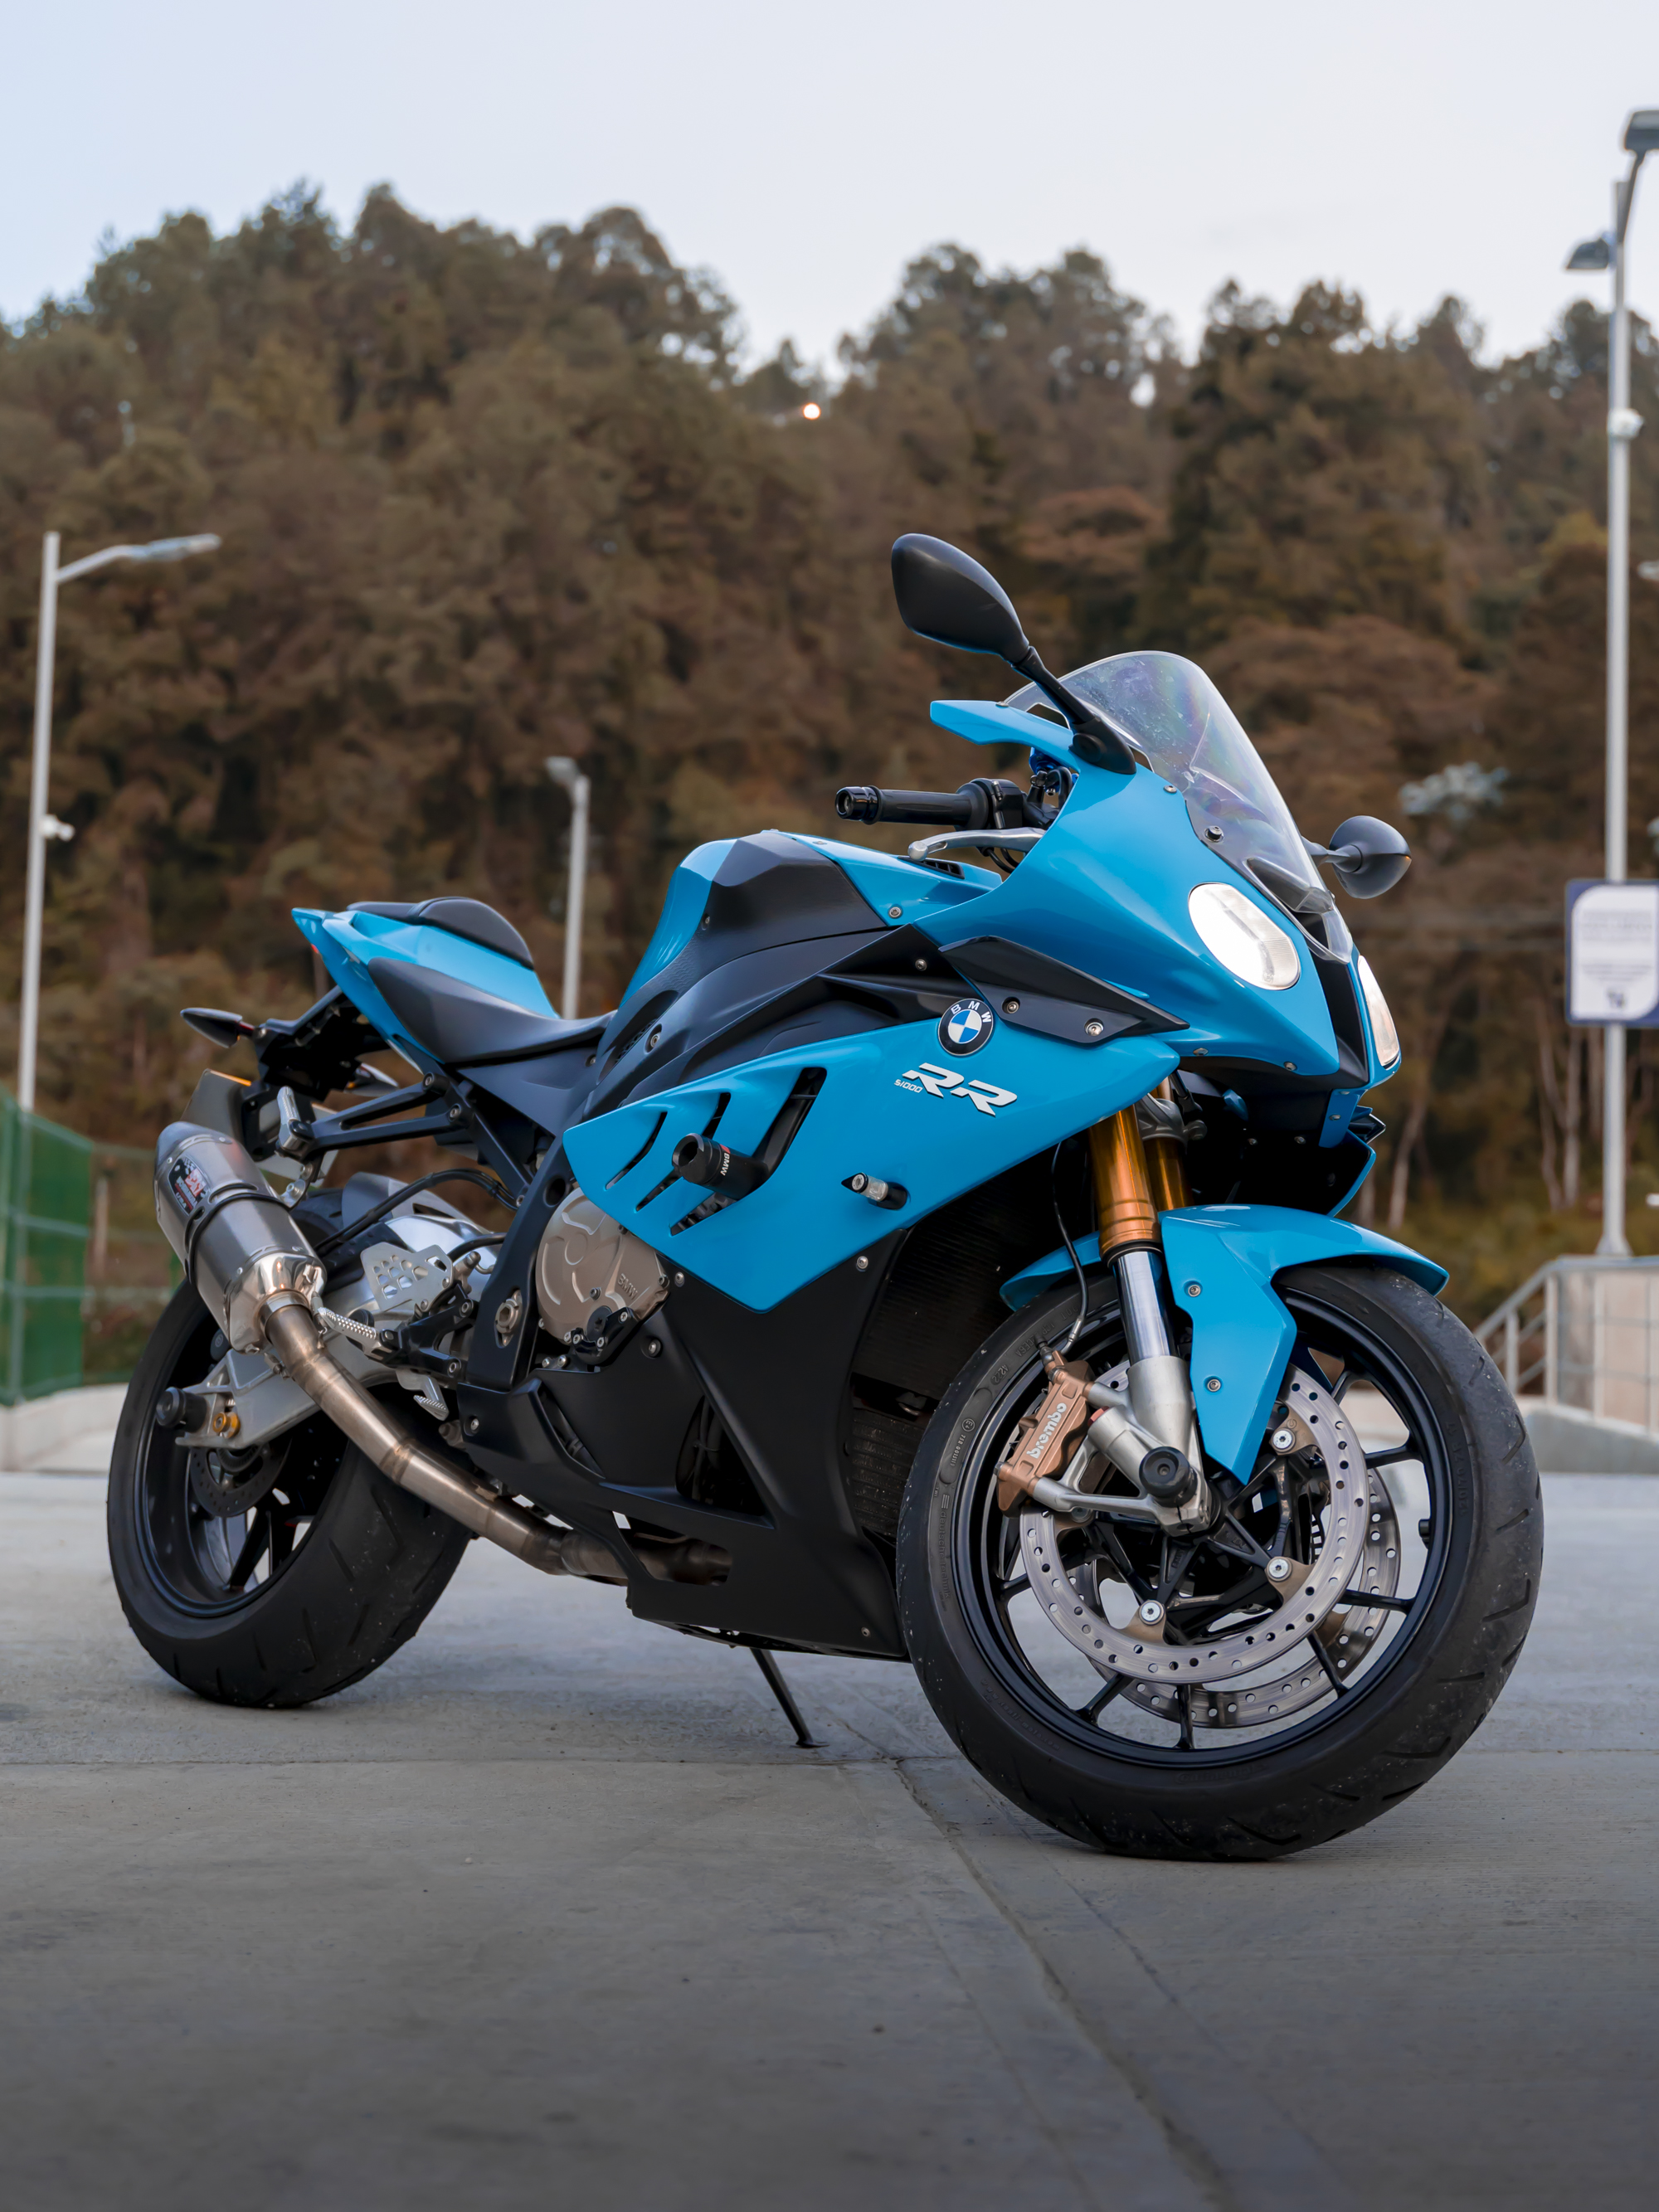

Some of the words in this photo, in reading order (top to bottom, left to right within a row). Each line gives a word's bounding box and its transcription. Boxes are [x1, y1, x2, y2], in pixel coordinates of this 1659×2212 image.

[951, 1001, 991, 1023] BMW
[894, 1079, 923, 1093] S1000
[902, 1062, 1018, 1117] RR
[720, 1152, 730, 1176] BMW
[617, 1273, 638, 1300] BMW
[991, 1364, 1010, 1383] 4222
[1026, 1403, 1067, 1459] brembo
[938, 1510, 947, 1558] deutsche
[939, 1561, 951, 1598] technik
